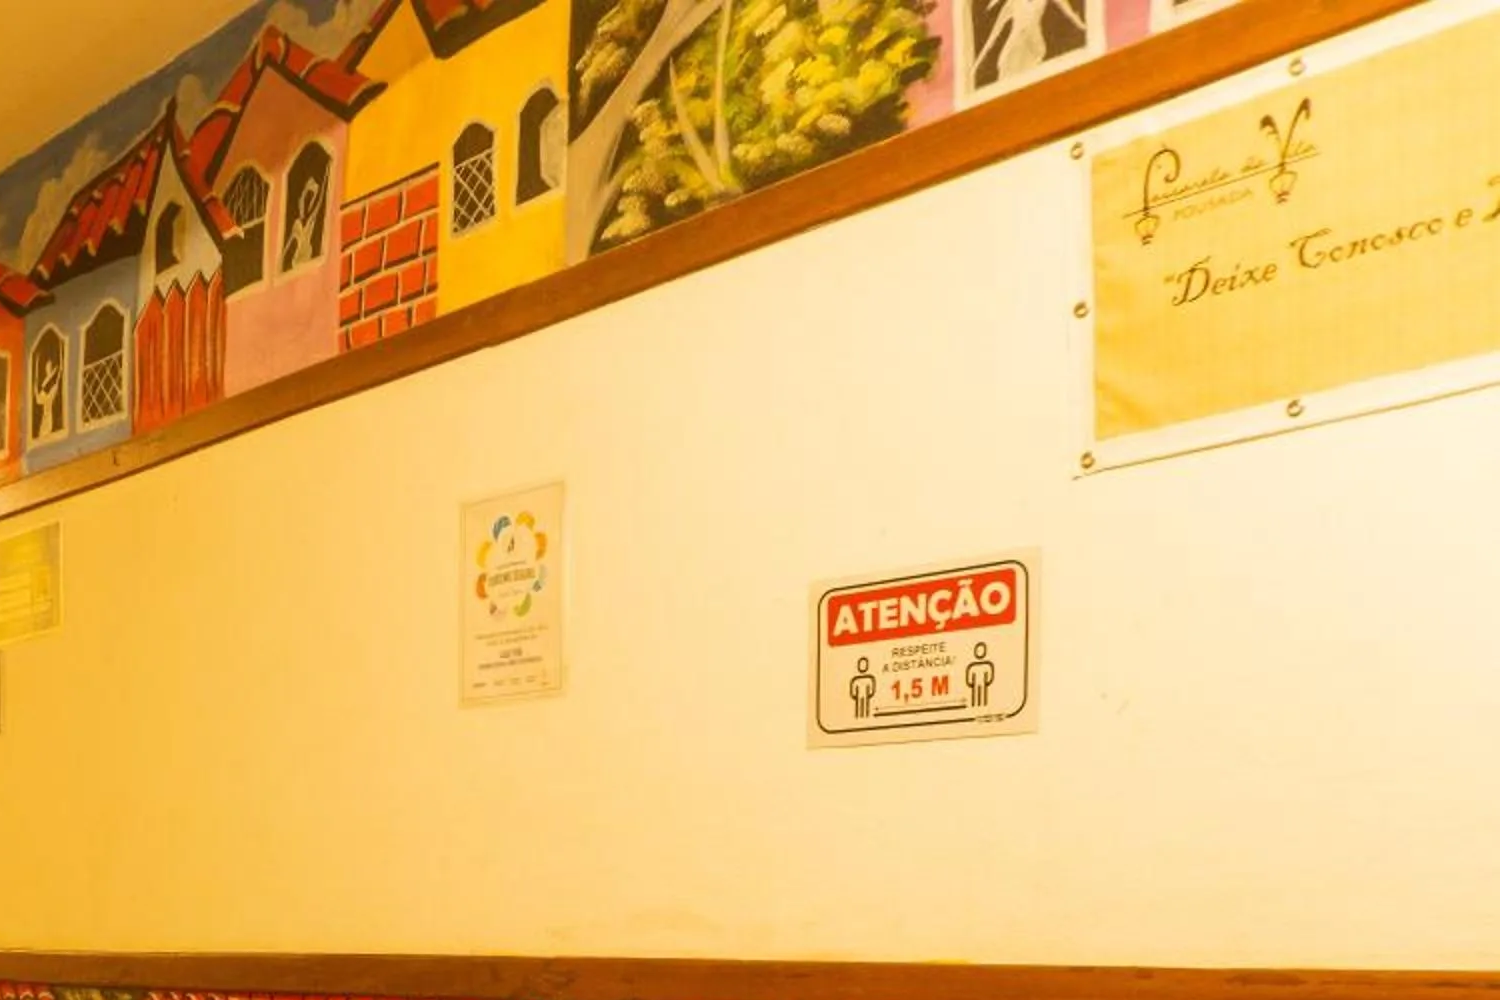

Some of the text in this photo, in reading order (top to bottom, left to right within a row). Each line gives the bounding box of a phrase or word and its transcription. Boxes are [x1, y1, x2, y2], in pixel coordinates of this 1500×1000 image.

[1172, 186, 1255, 221] POUSADA
[1453, 206, 1474, 229] e
[833, 578, 1011, 637] ATENÇÃO
[891, 641, 947, 657] RESPEITE
[882, 663, 890, 673] A
[891, 675, 949, 703] 1,5 M
